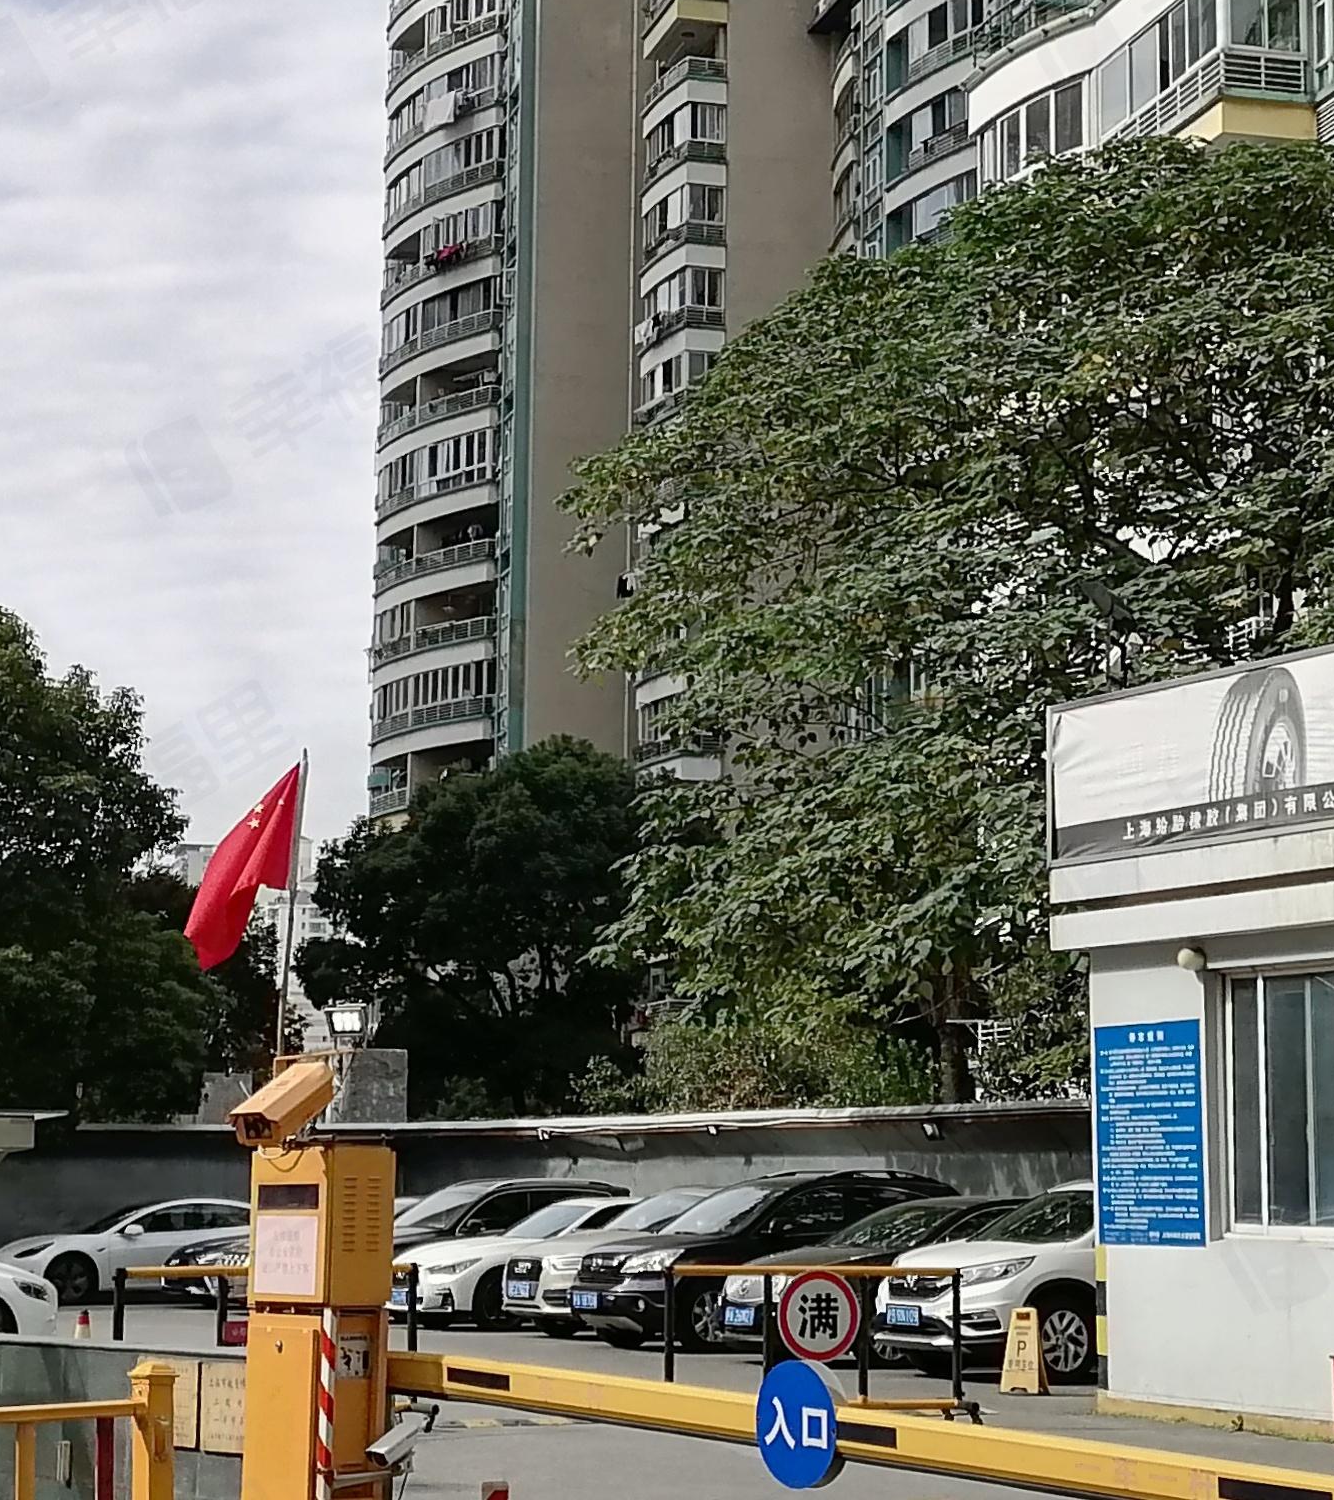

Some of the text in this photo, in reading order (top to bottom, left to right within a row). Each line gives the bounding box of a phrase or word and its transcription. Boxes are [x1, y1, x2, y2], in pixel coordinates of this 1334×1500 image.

[798, 1292, 840, 1340] 满
[1017, 1340, 1027, 1357] P
[764, 1395, 829, 1450] 入口
